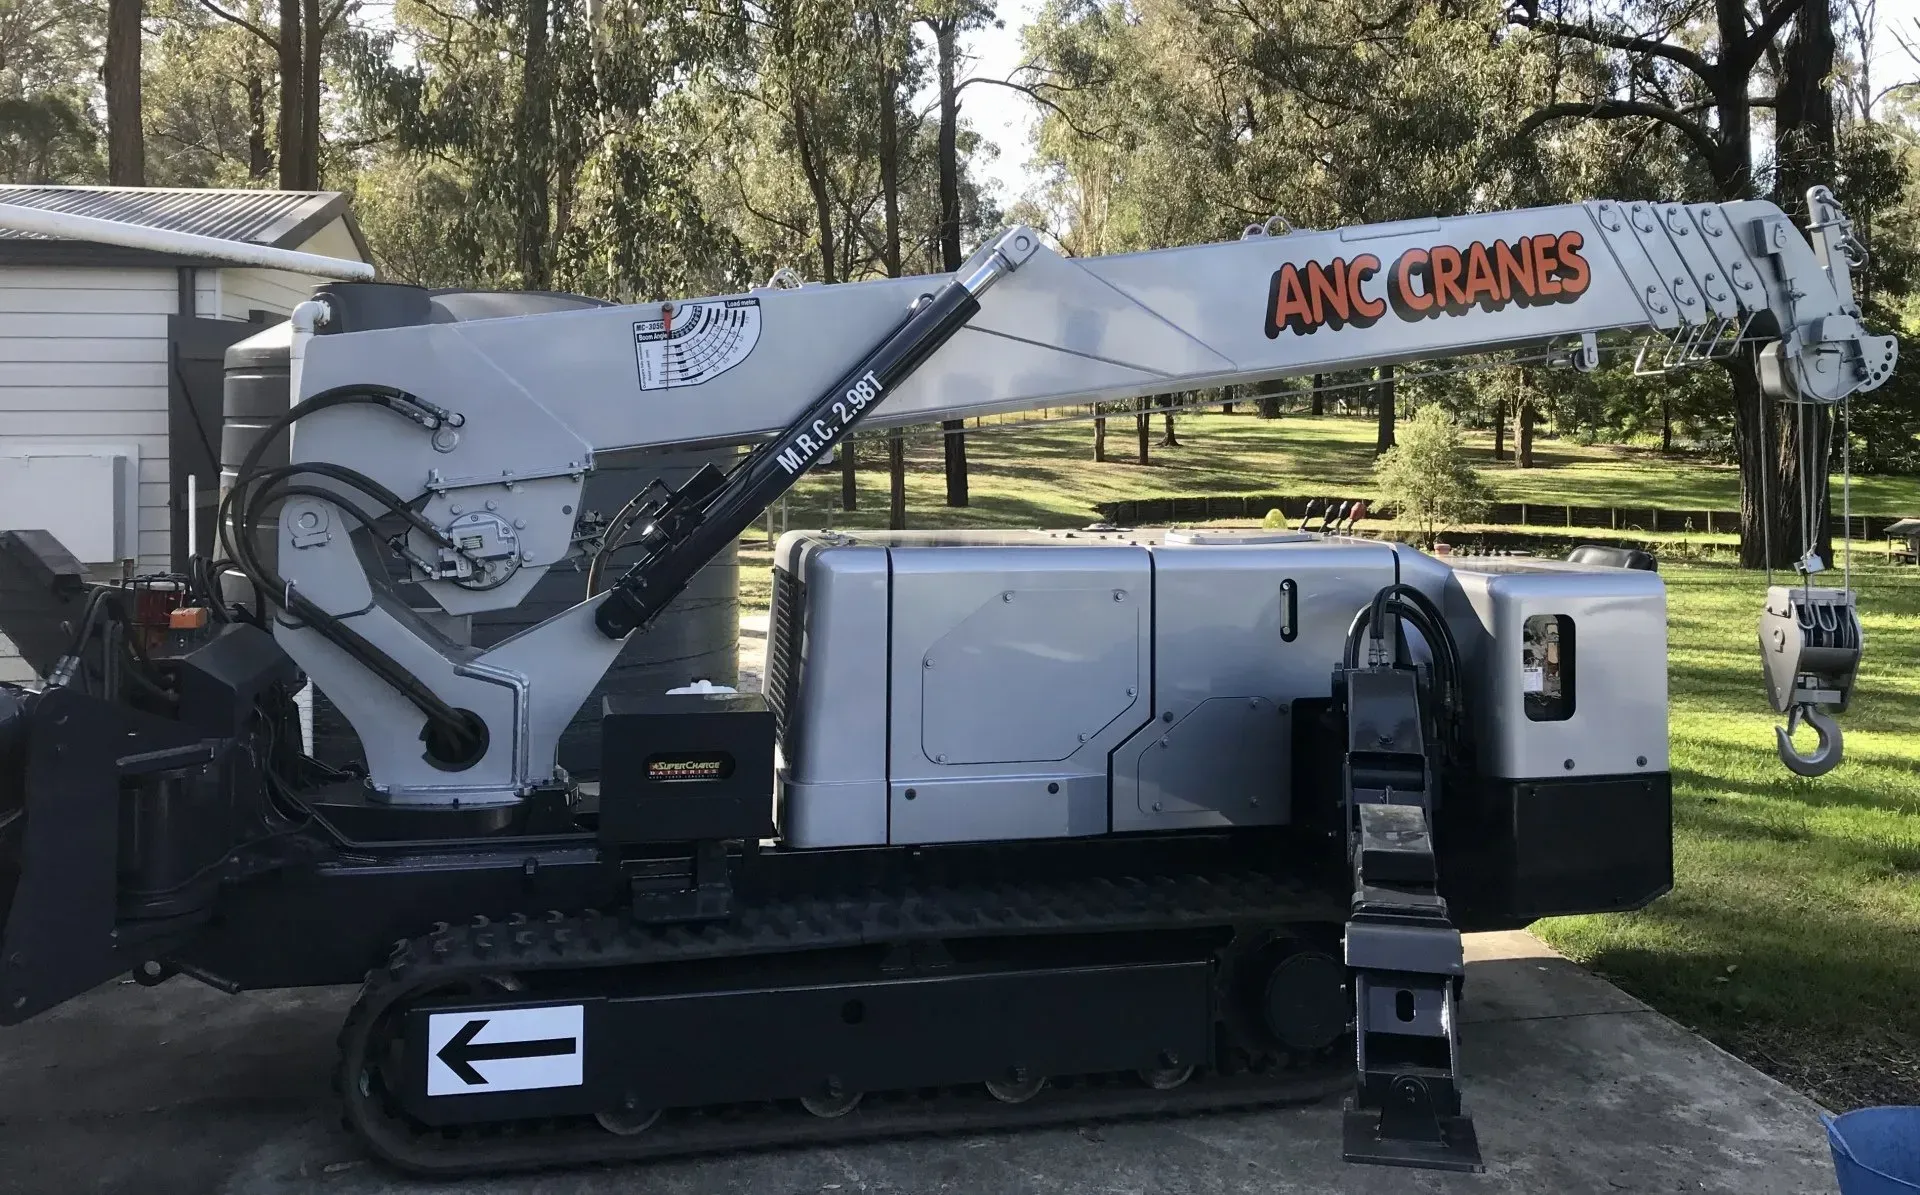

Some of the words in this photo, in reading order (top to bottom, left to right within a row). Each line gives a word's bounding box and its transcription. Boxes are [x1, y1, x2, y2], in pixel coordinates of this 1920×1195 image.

[638, 333, 653, 341] Boom
[653, 332, 668, 341] Angle
[1265, 253, 1387, 338] ANC
[1388, 231, 1591, 322] CRANES
[776, 419, 839, 475] M.R.C.
[832, 370, 883, 424] 2.98T
